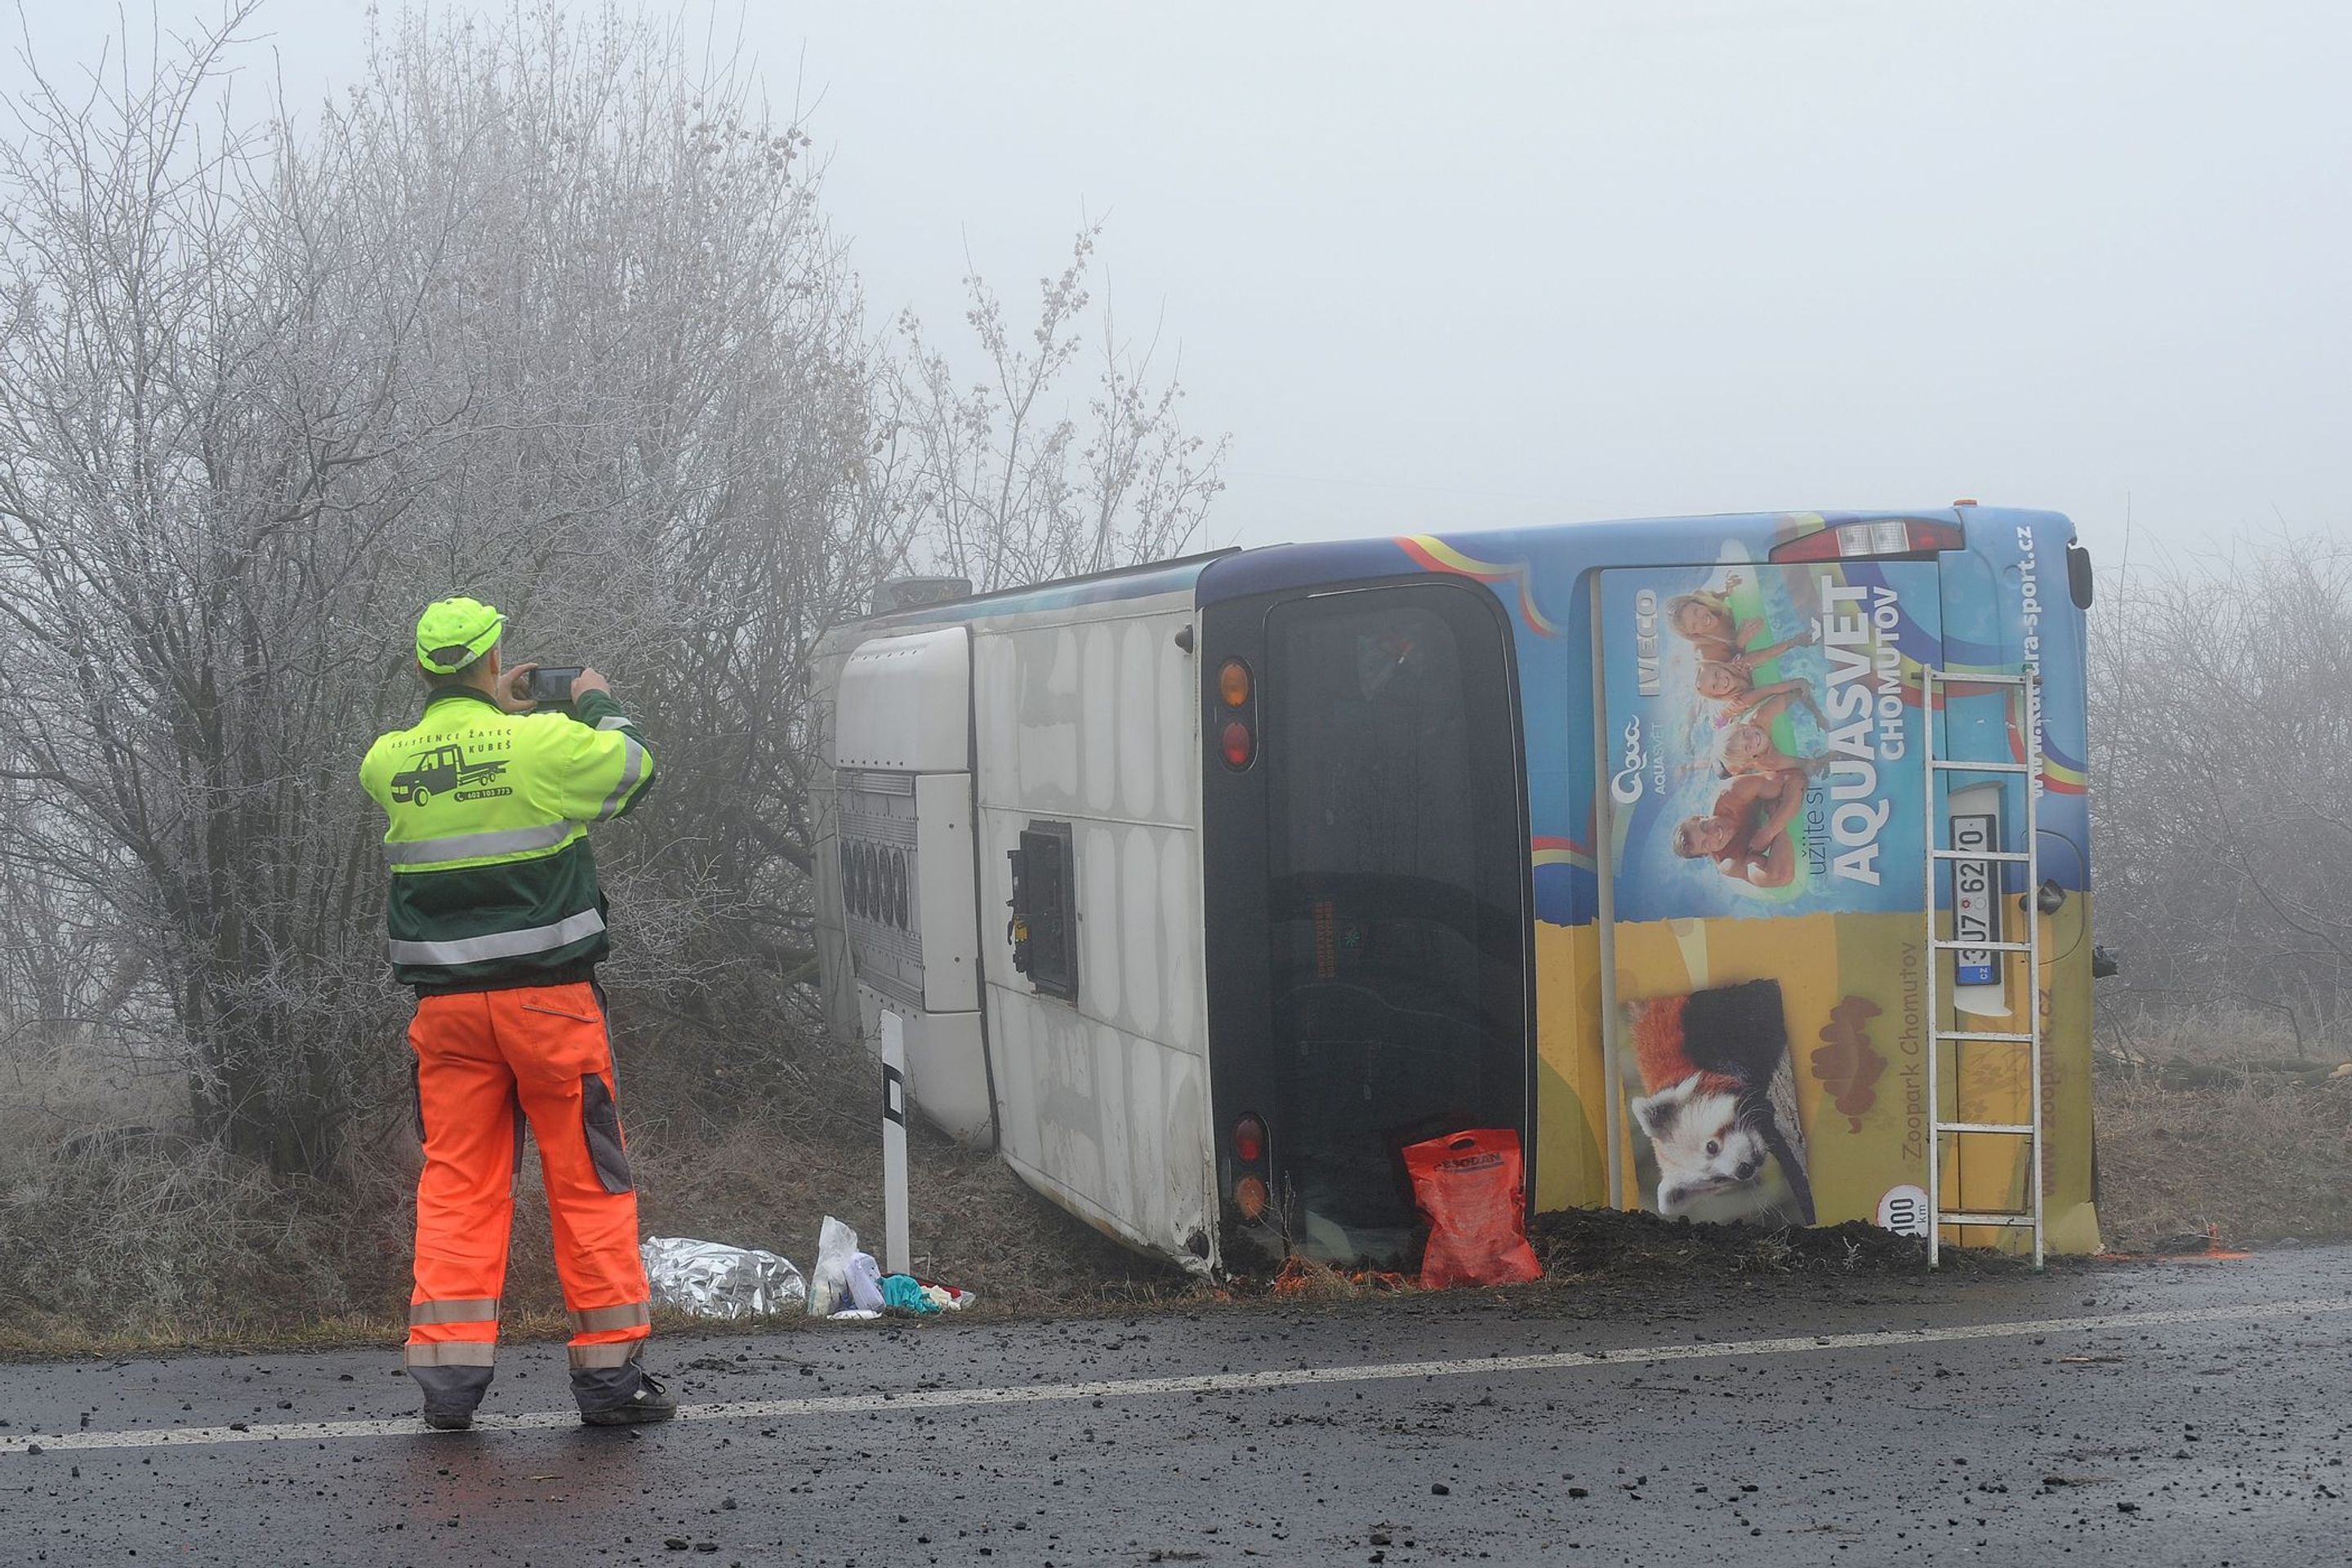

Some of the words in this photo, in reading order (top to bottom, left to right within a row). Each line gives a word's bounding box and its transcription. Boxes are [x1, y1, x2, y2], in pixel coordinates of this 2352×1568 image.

[1636, 588, 1660, 697] IVECO
[1873, 586, 1905, 761] CHOMUTOV
[468, 739, 511, 754] KUBEŠ
[469, 728, 512, 739] ŽATEC
[1649, 722, 1666, 795] AQUASVĚT
[1811, 574, 1891, 886] AQUASVĚT
[1801, 786, 1824, 804] si
[1802, 809, 1832, 875] užijte
[1958, 831, 1985, 893] 620
[1961, 915, 1987, 960] 3U7
[1898, 942, 1919, 1056] Chomutov
[1980, 966, 1989, 980] CZ
[1900, 1063, 1927, 1160] Zoopark
[1889, 1198, 1915, 1231] 100
[1917, 1204, 1927, 1223] km
